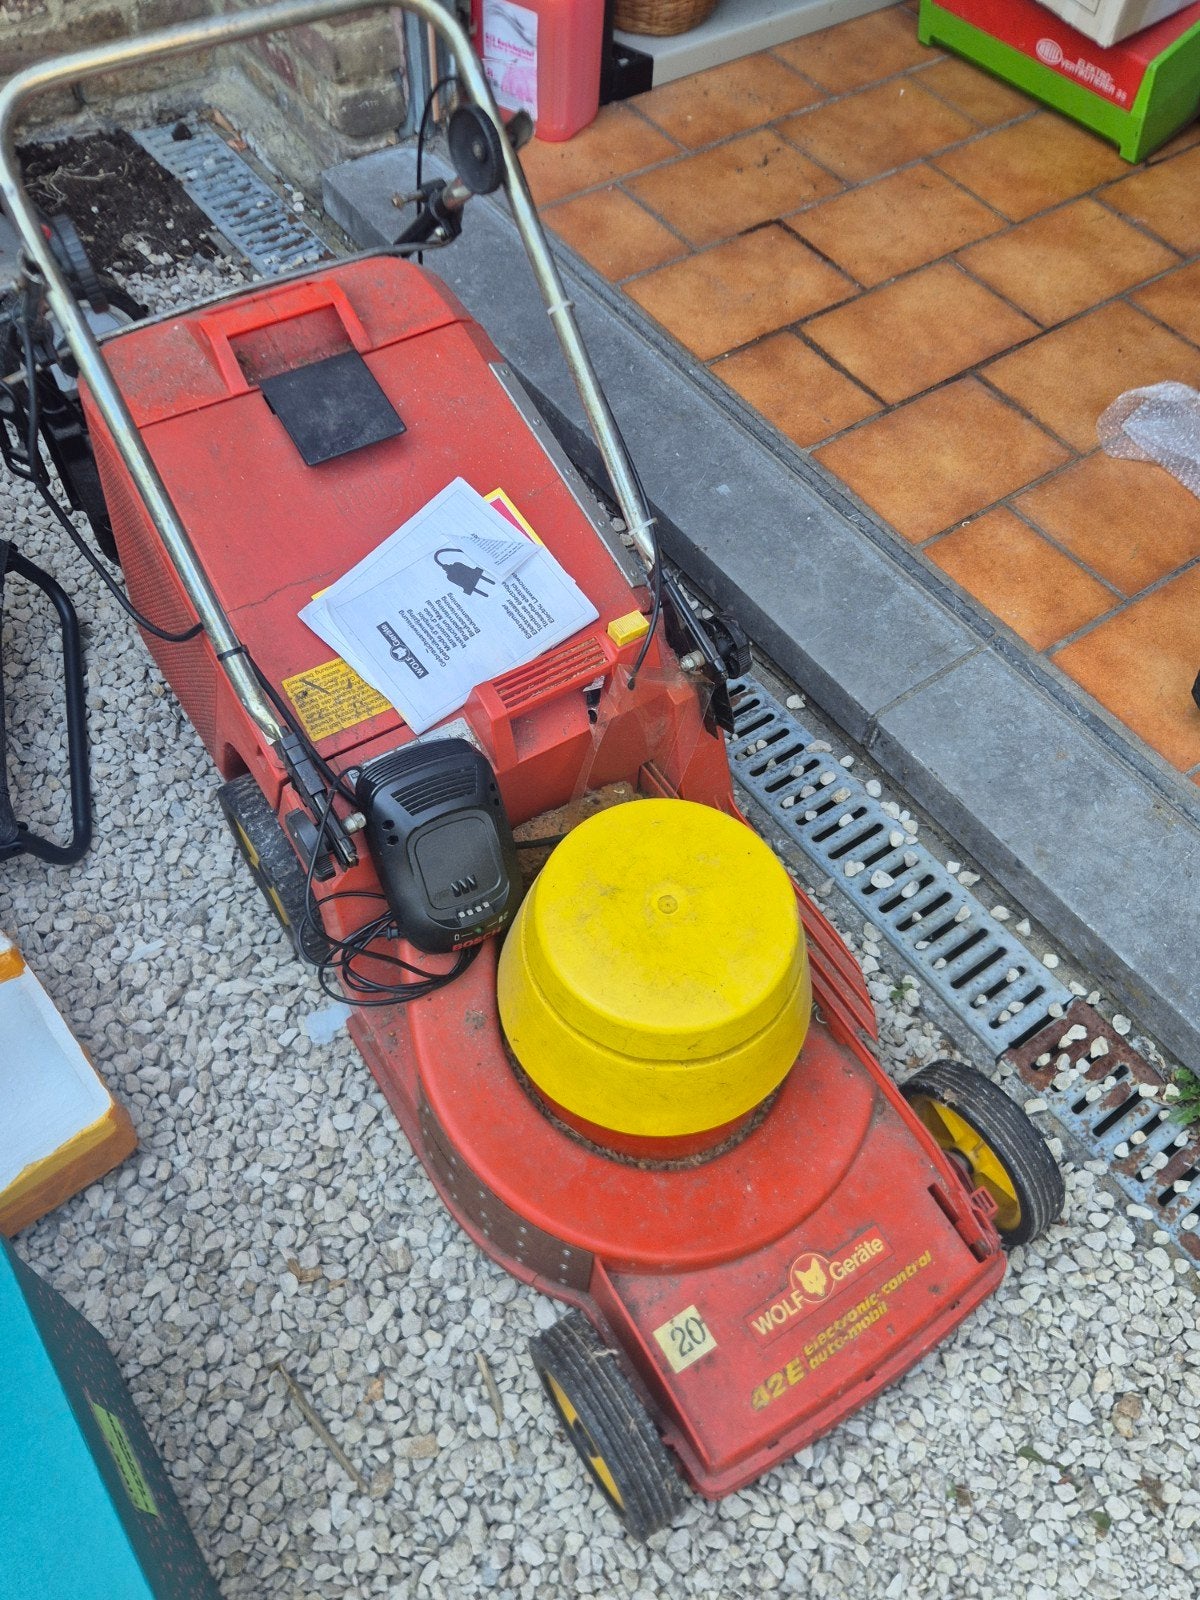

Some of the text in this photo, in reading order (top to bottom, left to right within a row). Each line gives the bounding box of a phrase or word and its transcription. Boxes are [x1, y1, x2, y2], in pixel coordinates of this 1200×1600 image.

[424, 599, 466, 648] Instruction Manual
[536, 603, 554, 623] Electric
[380, 623, 424, 676] WOLF Geräte
[397, 609, 446, 667] Gebrauchsanweisung
[436, 634, 451, 651] Mode
[452, 927, 501, 951] BOSCH
[751, 1238, 884, 1335] WOLF Geräte
[670, 1317, 706, 1357] 20
[751, 1301, 888, 1411] 42E auto-mobil
